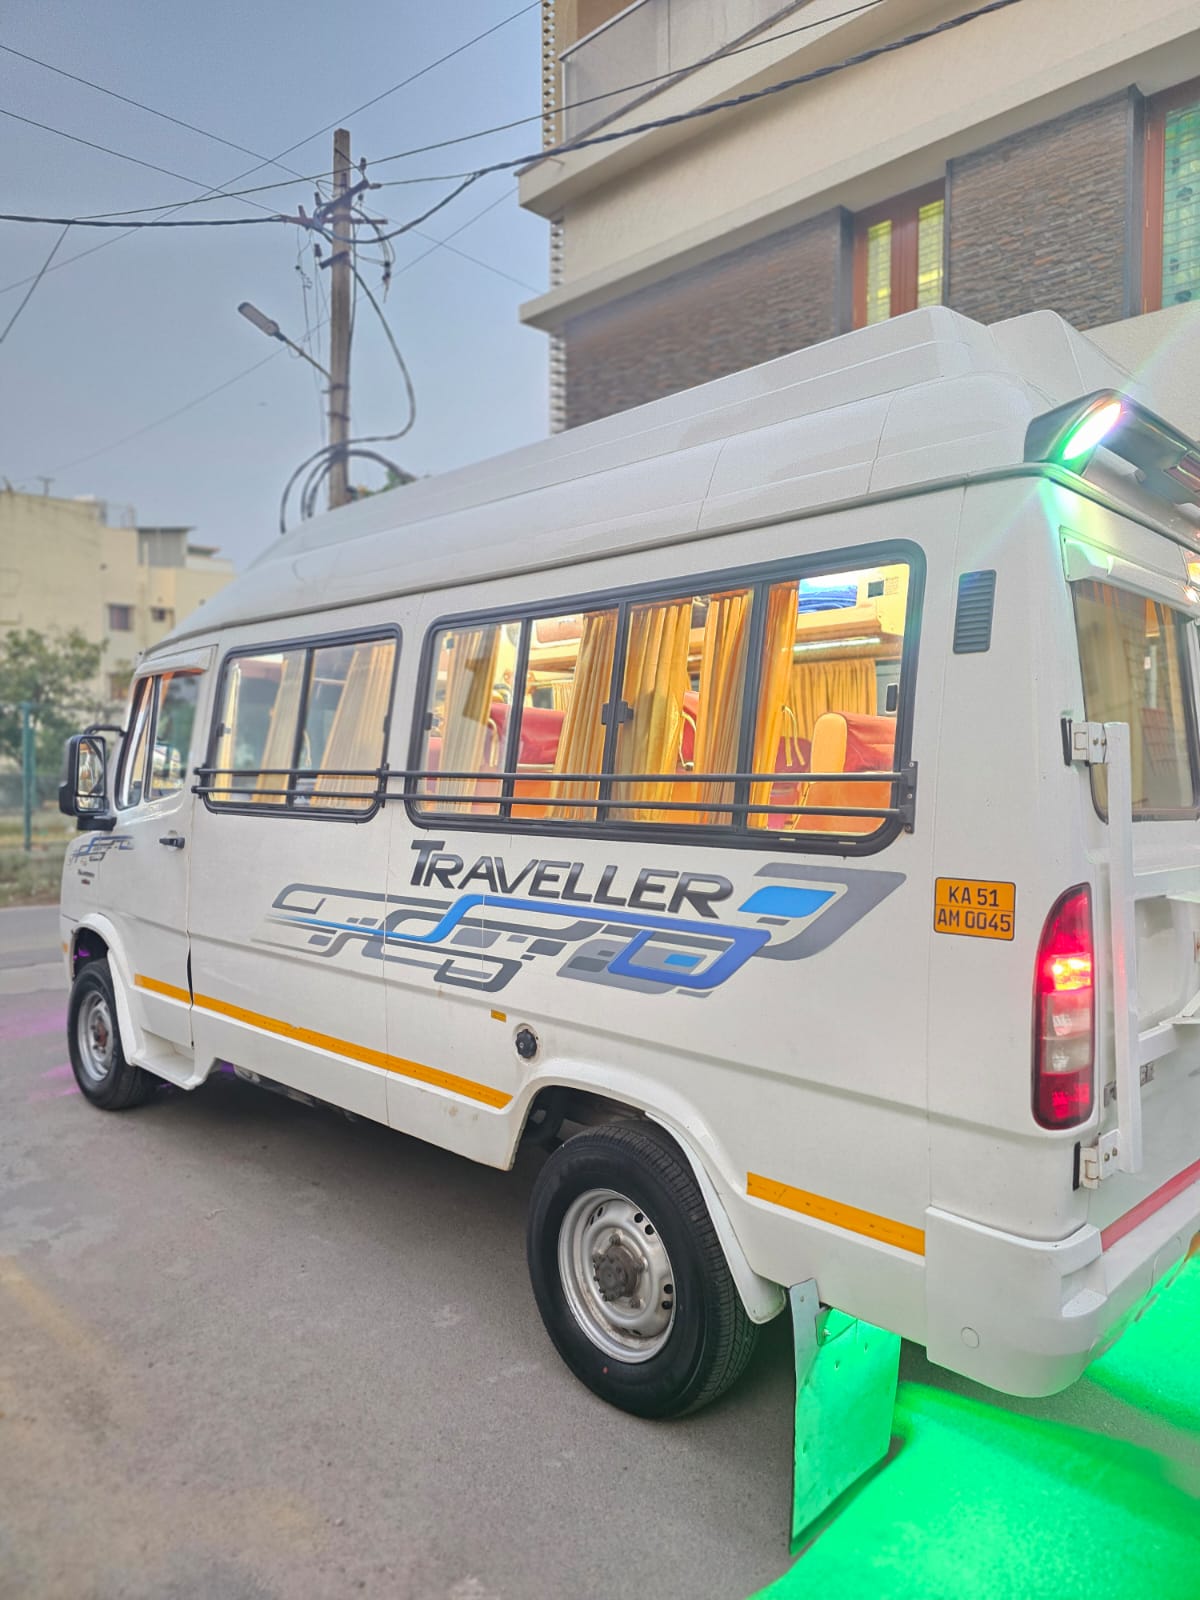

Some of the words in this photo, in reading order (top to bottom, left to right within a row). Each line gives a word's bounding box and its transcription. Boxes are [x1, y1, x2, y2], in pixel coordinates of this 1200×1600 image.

[410, 840, 734, 919] TRAVELLER
[948, 885, 971, 905] KA
[977, 888, 999, 907] 51
[937, 908, 960, 927] AM
[965, 910, 1011, 932] 0045
